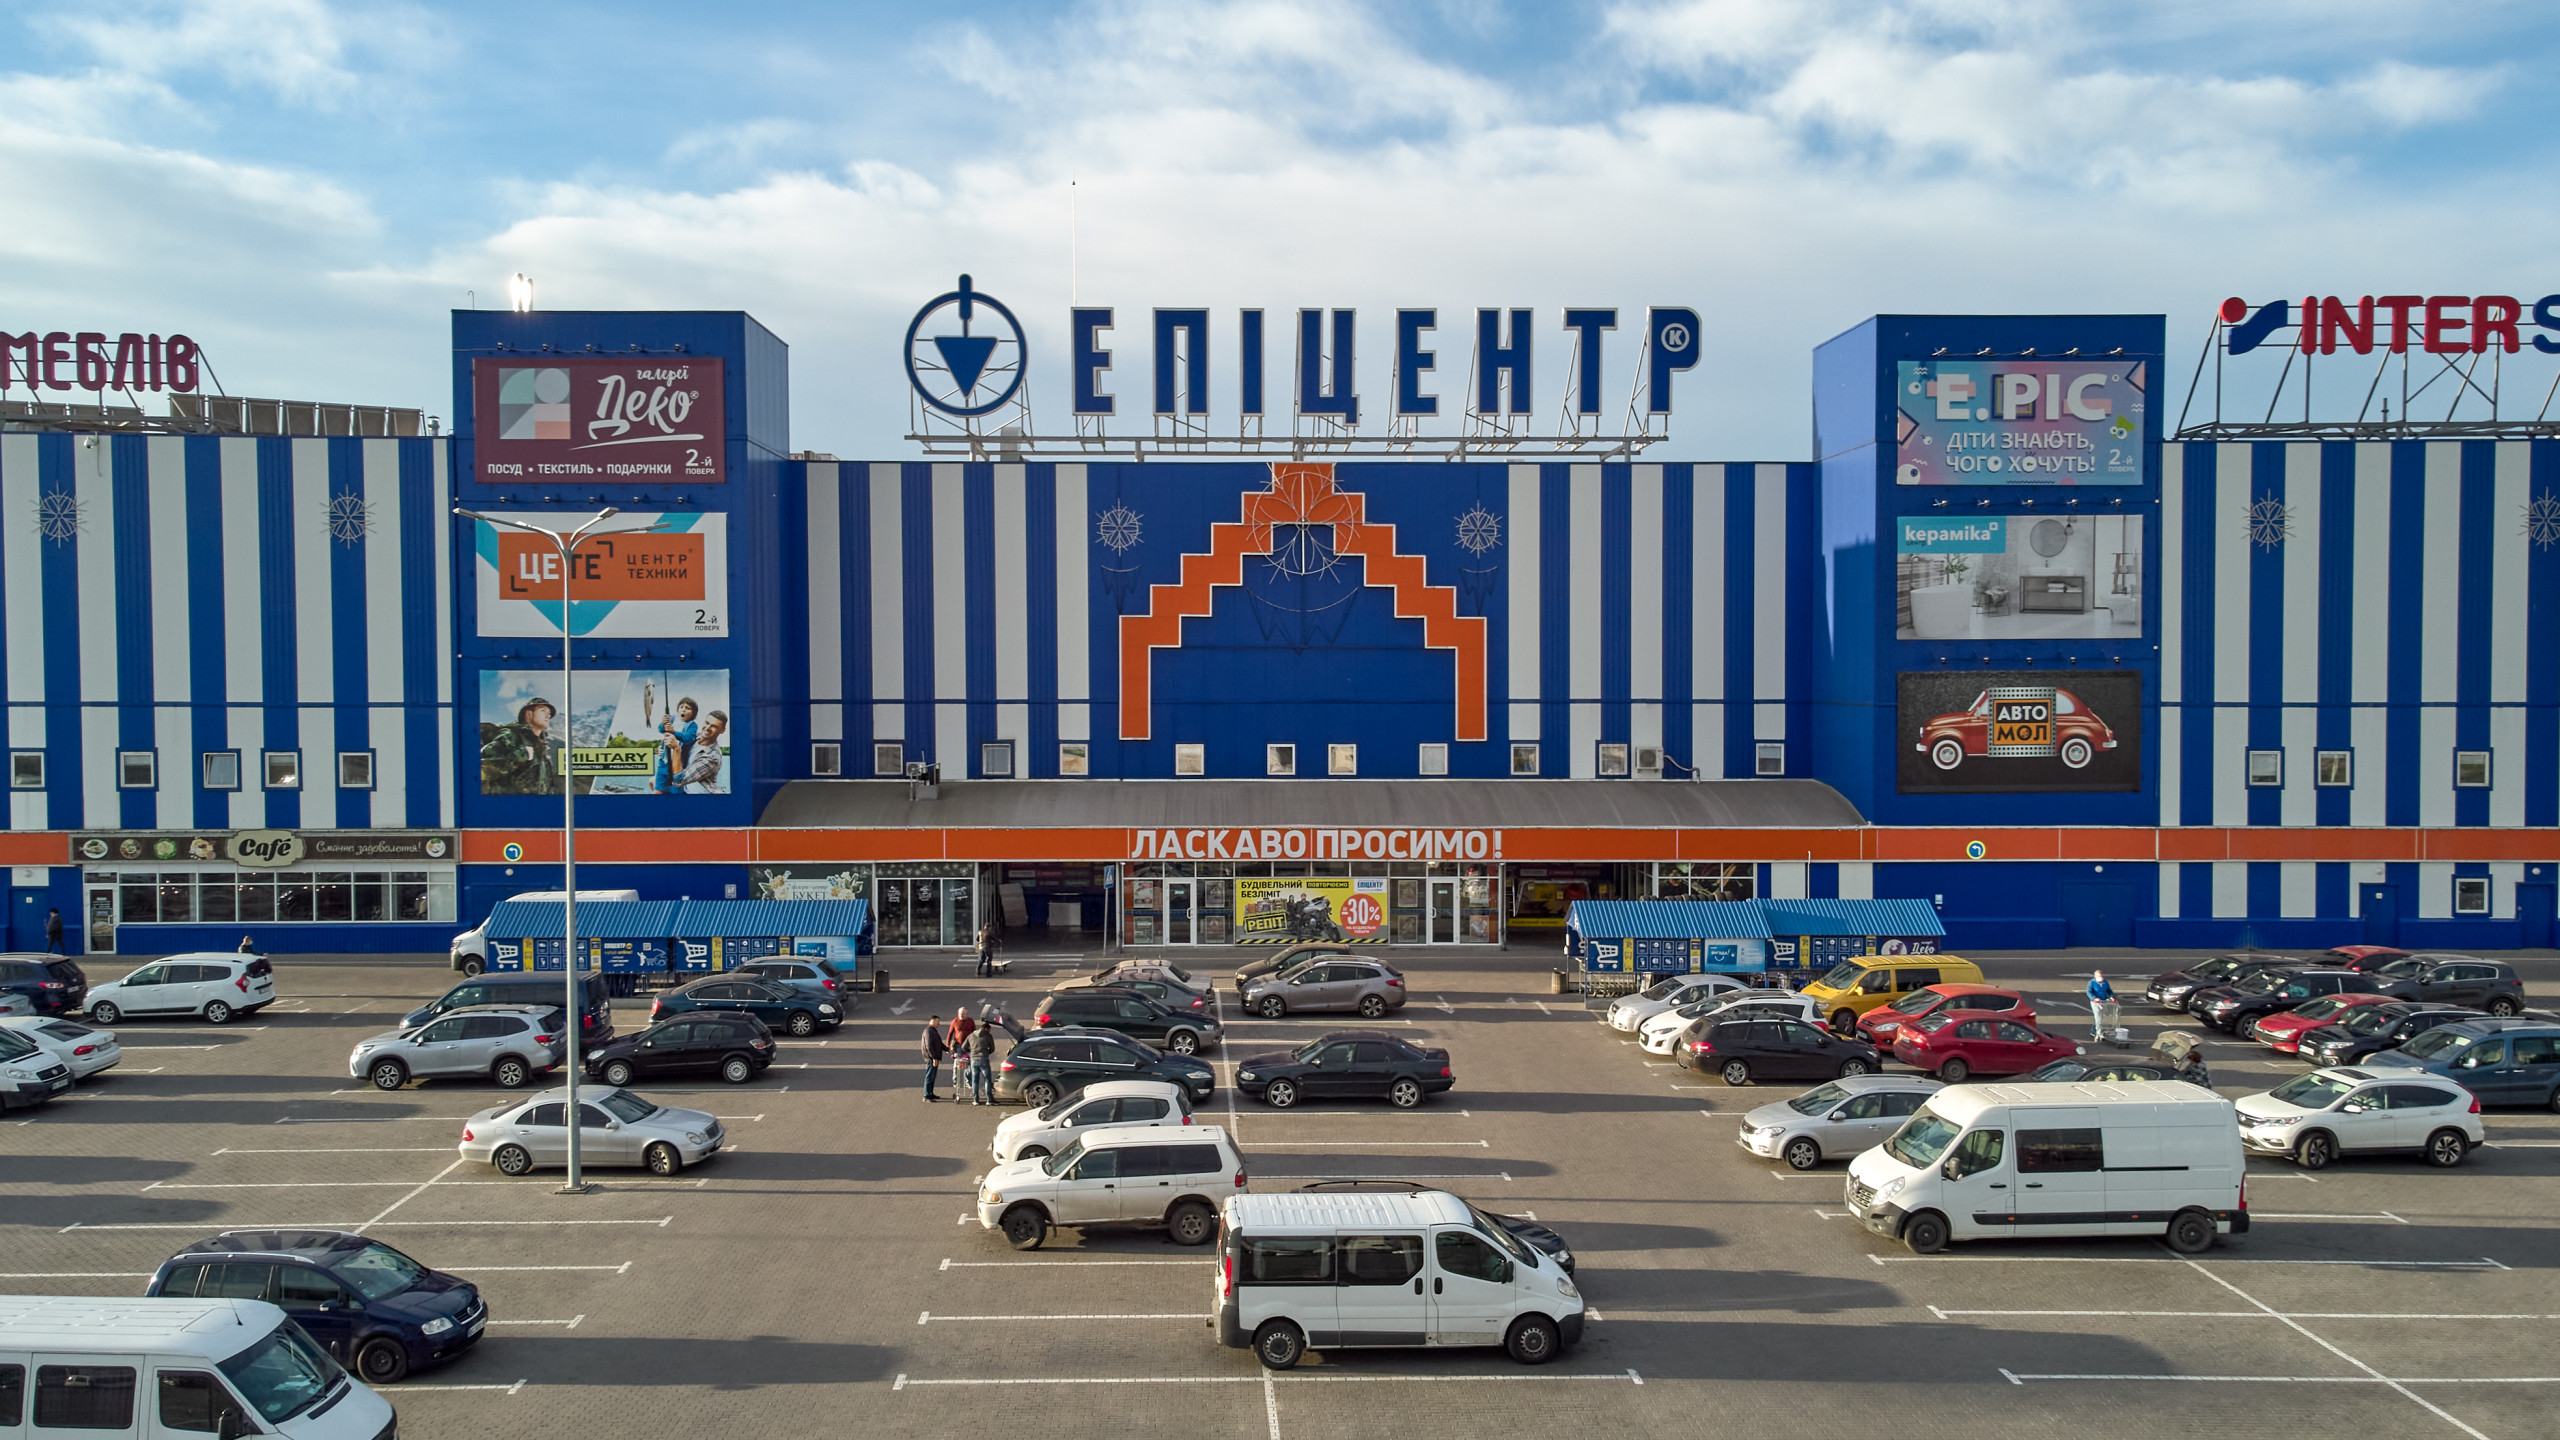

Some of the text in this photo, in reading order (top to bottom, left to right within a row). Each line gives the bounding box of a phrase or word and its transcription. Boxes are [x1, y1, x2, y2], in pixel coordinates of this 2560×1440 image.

[1070, 306, 1702, 427] ЕПІЦЕНТР
[1935, 373, 2108, 421] E.PIC
[1946, 430, 2095, 453] ДІТИ ЗНАЮТЬ,
[487, 463, 672, 477] ПОСУД ТЕКСТИЛЬ ПОДАРУНКИ
[685, 467, 715, 475] ПОВЕРХ
[1946, 455, 2095, 473] ЧОГО ХОЧУТЬ!
[627, 553, 688, 566] ЦЕНТР
[627, 567, 688, 579] ТЕХНІКИ
[1997, 705, 2048, 721] АВТО
[1996, 725, 2048, 742] МОЛ
[238, 838, 292, 862] Café
[1131, 829, 1503, 860] ЛАСКАВО ПРОСИМО!
[1241, 880, 1303, 890] БУДІВЕЛЬНИЙ
[1241, 890, 1281, 898] БЕЗЛІМІТ
[1248, 916, 1284, 931] РЕПІТ
